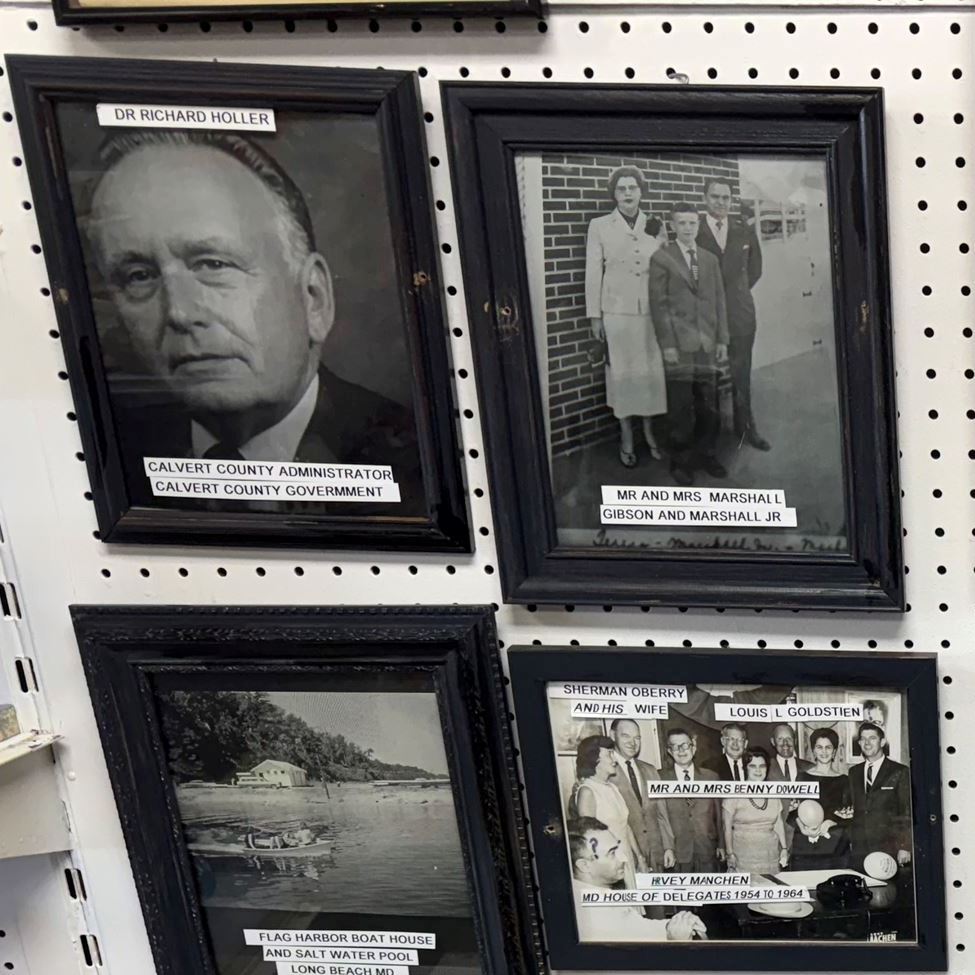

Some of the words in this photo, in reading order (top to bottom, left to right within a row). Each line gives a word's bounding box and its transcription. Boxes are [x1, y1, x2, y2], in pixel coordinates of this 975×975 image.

[115, 108, 136, 121] DR
[140, 109, 206, 122] RICHARD
[212, 112, 269, 125] HOLLER
[148, 461, 212, 474] CALVERT
[216, 463, 274, 477] COUNTY
[279, 466, 392, 480] ADMINISTRATOR
[617, 490, 637, 500] MR
[641, 490, 669, 501] AND
[673, 491, 702, 501] MRS
[709, 492, 782, 504] MARSHALL
[603, 509, 654, 520] GIBSON
[658, 510, 686, 521] AND
[690, 511, 761, 522] MARSHALL
[765, 511, 781, 522] JR
[563, 683, 628, 698] SHERMAN
[631, 686, 685, 699] OBERRY
[634, 704, 667, 716] WIFE
[730, 707, 768, 718] LOUIS
[775, 708, 783, 718] L
[787, 707, 861, 718] GOLDSTIEN
[582, 891, 600, 903] MD
[603, 890, 638, 902] HOUSE
[641, 891, 659, 902] OF
[663, 889, 732, 902] DELEGATES
[733, 889, 761, 900] 1954
[763, 889, 775, 900] TO
[777, 889, 804, 899] 1964
[259, 933, 291, 942] FLAG
[295, 933, 348, 943] HARBOR
[351, 934, 385, 943] BOAT
[390, 935, 433, 945] HOUSE
[265, 949, 292, 958] AND
[295, 950, 327, 959] SALT
[330, 951, 376, 960] WATER
[379, 952, 414, 962] POOL
[291, 965, 326, 974] LONG
[330, 966, 372, 975] BEACH
